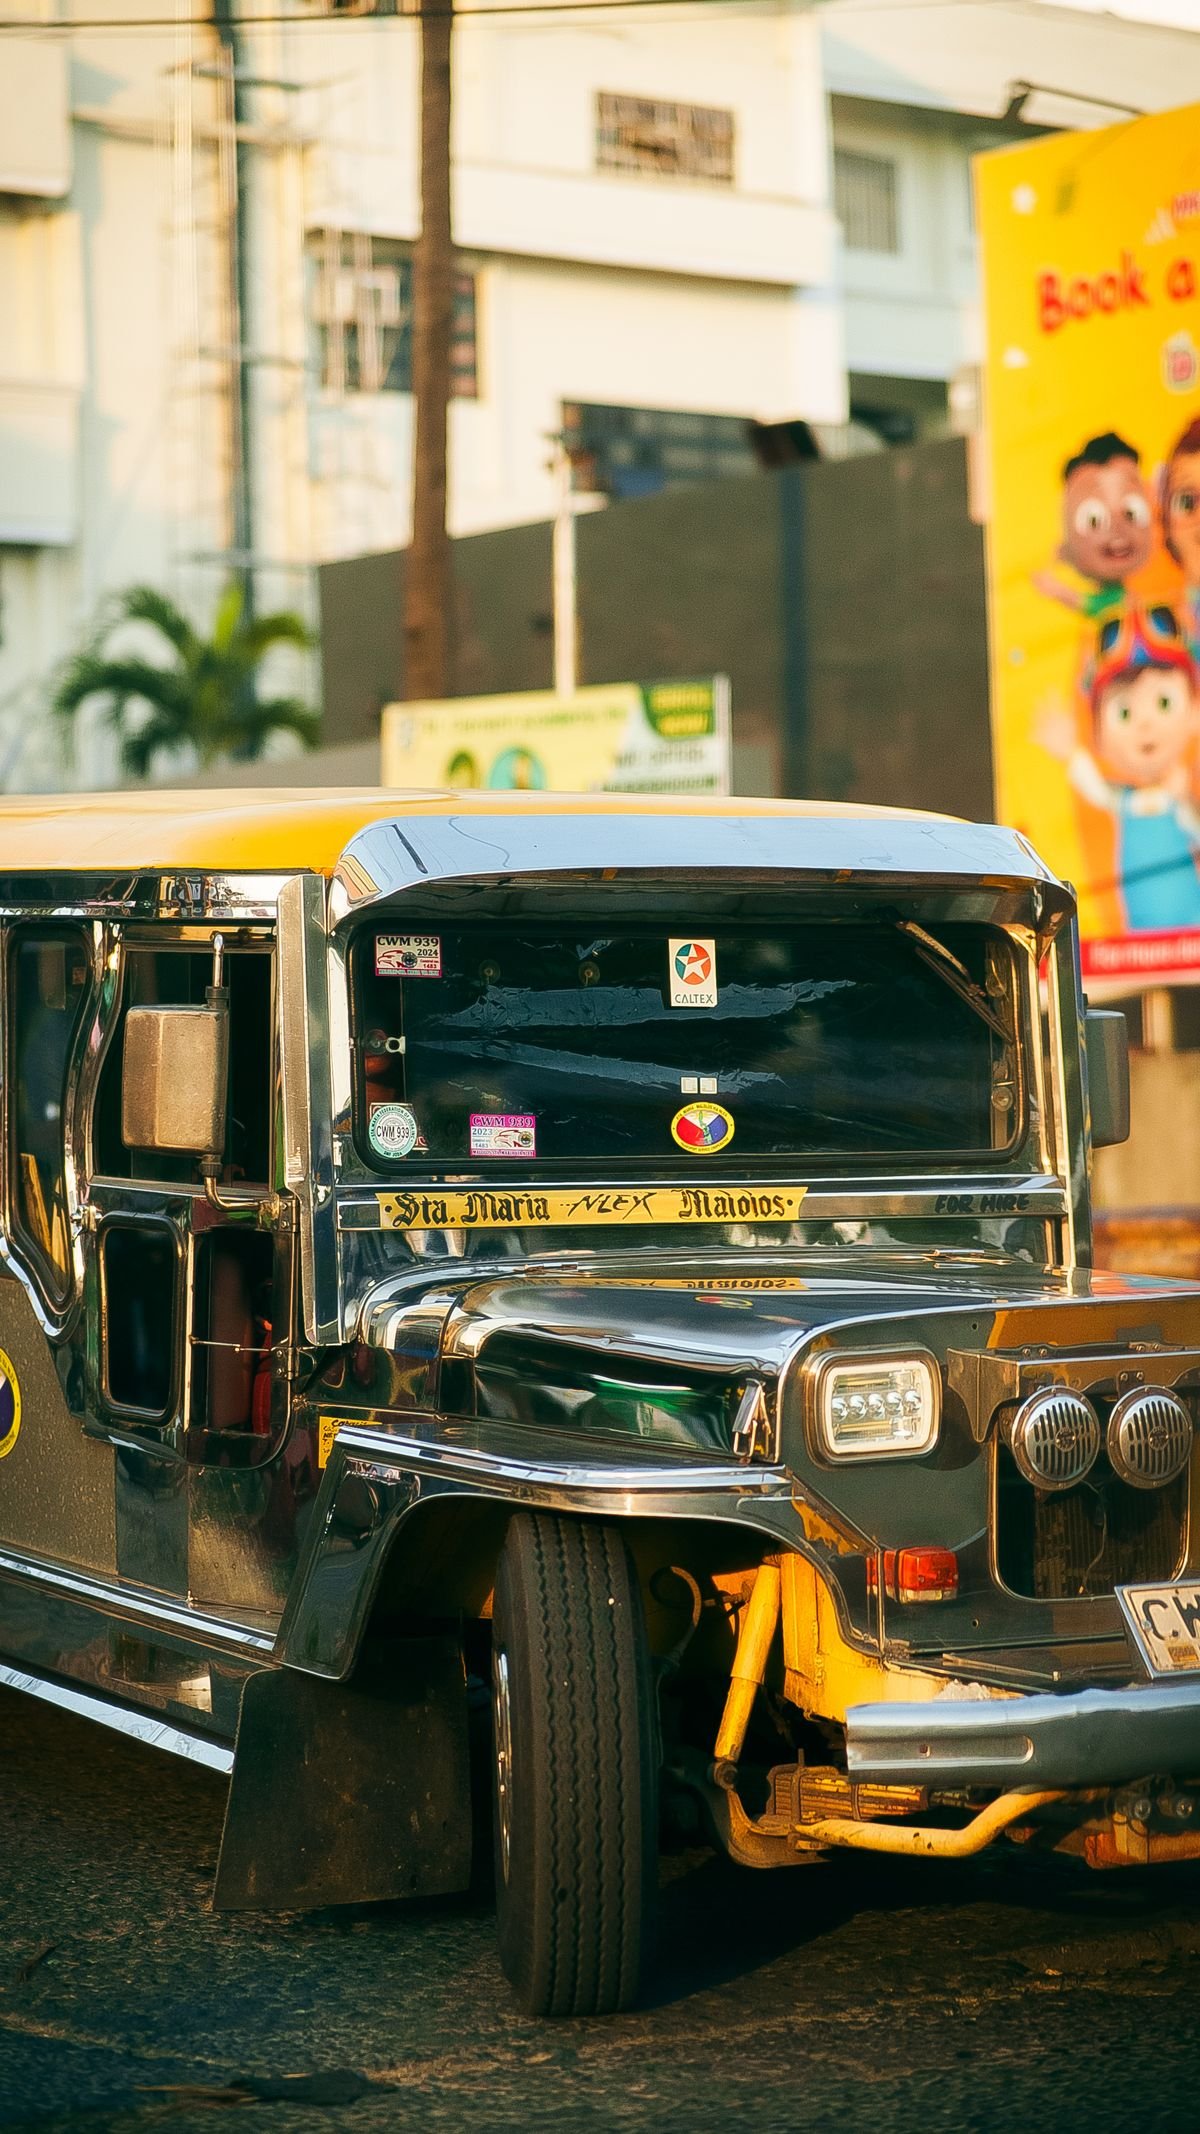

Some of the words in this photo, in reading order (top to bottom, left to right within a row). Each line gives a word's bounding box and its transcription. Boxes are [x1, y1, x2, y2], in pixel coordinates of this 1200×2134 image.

[1039, 250, 1149, 334] Book
[1167, 259, 1195, 302] a
[377, 936, 411, 946] CWM
[413, 937, 439, 947] 939
[417, 948, 439, 956] 2024
[674, 993, 714, 1004] CALTEX
[473, 1116, 505, 1127] CWM
[509, 1117, 533, 1128] 939
[376, 1125, 395, 1138] CWM
[396, 1126, 410, 1139] 939
[472, 1127, 493, 1136] 2023
[934, 1194, 975, 1214] FOR
[980, 1193, 1030, 1213] HIRE
[392, 1192, 456, 1228] Sta.
[456, 1192, 551, 1225] Maria
[567, 1192, 657, 1220] NLEX
